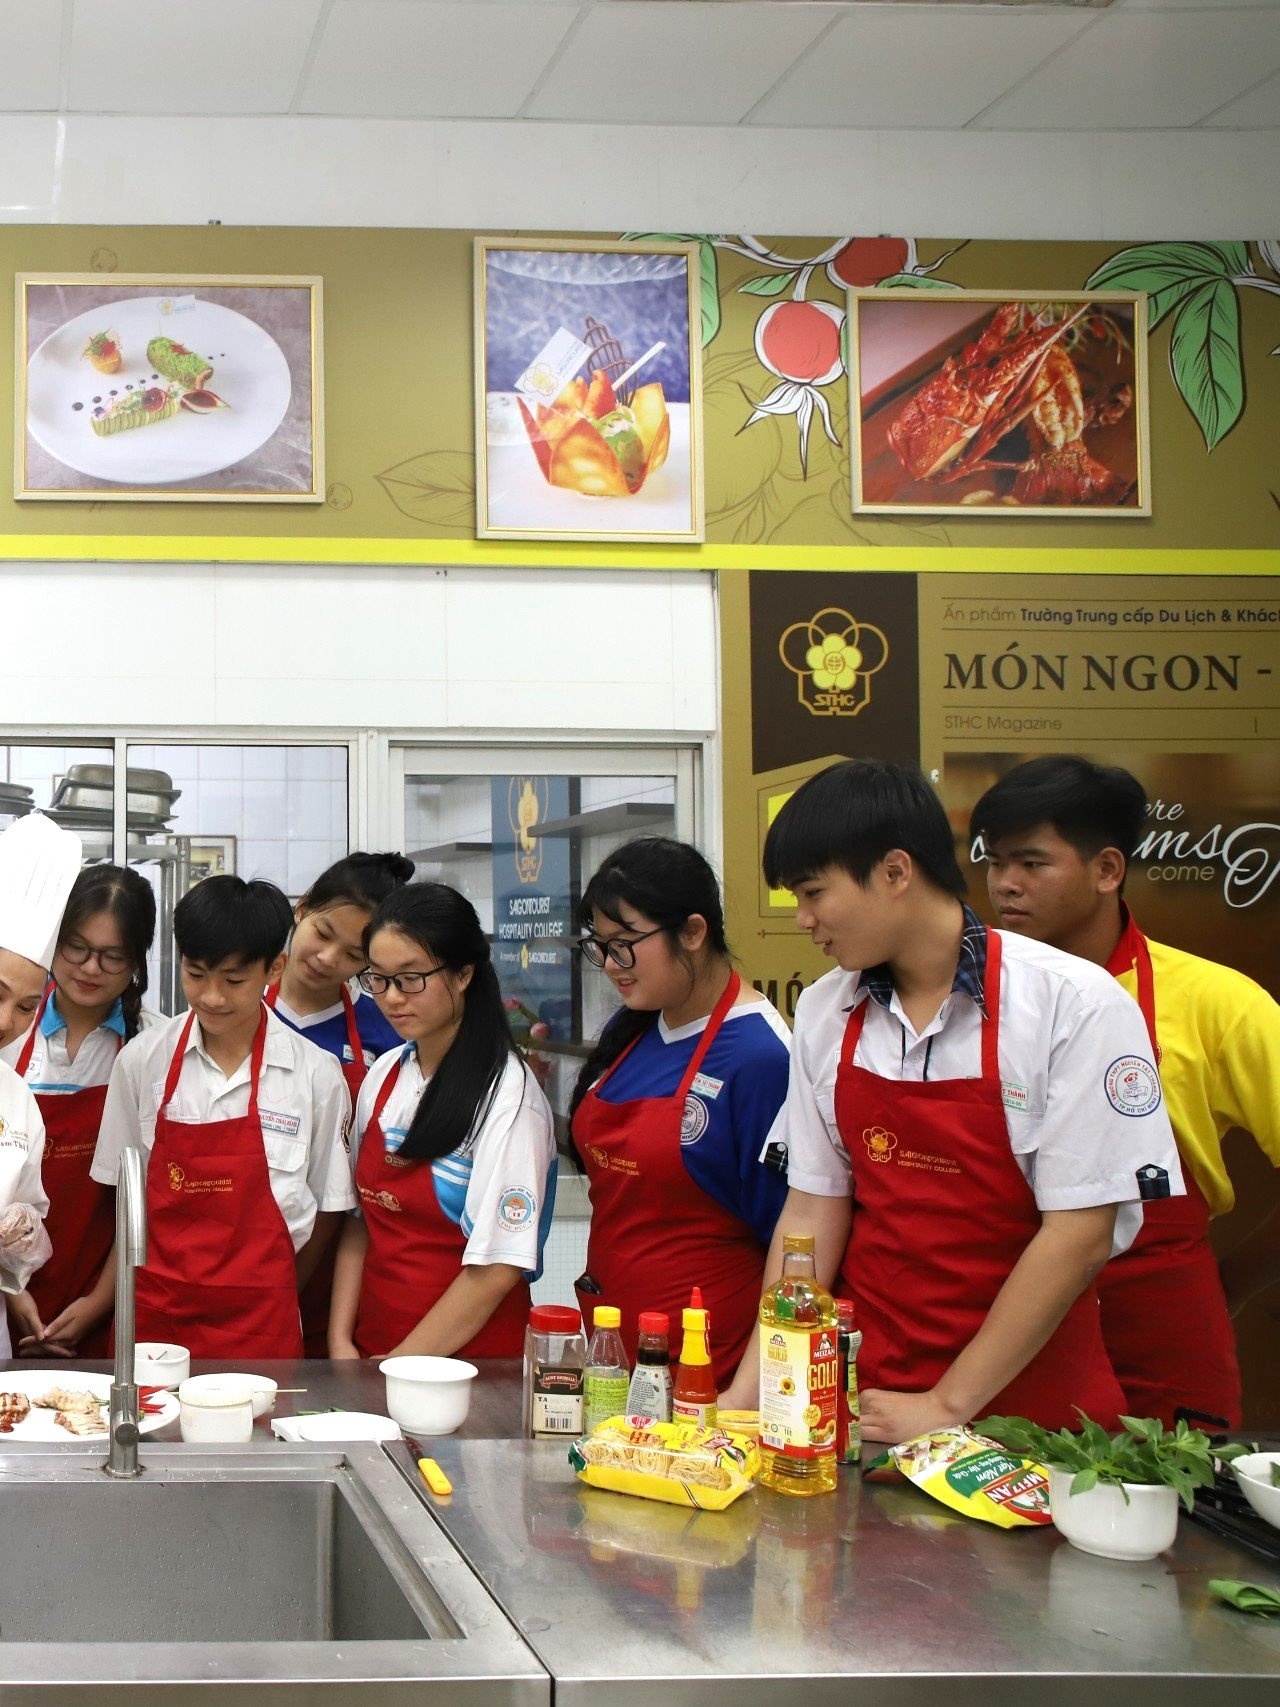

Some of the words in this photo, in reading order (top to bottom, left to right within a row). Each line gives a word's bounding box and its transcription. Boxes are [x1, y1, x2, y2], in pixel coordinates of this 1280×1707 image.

[1021, 608, 1073, 625] Trường
[1076, 609, 1117, 625] Trung
[1122, 607, 1154, 623] cấp
[1159, 610, 1180, 622] Du
[1185, 609, 1216, 625] Lịch
[1221, 609, 1232, 622] &
[1237, 608, 1280, 622] Khác
[943, 641, 1068, 691] MÓN
[1082, 655, 1241, 691] NGON
[813, 694, 854, 706] STHC
[945, 716, 982, 729] STHC
[987, 716, 1062, 732] Magazine
[1146, 866, 1215, 881] come
[498, 923, 533, 940] HOSPITALITY
[534, 921, 563, 937] COLLEGE
[813, 1347, 836, 1358] MEIZAN
[807, 1360, 838, 1391] GOLD
